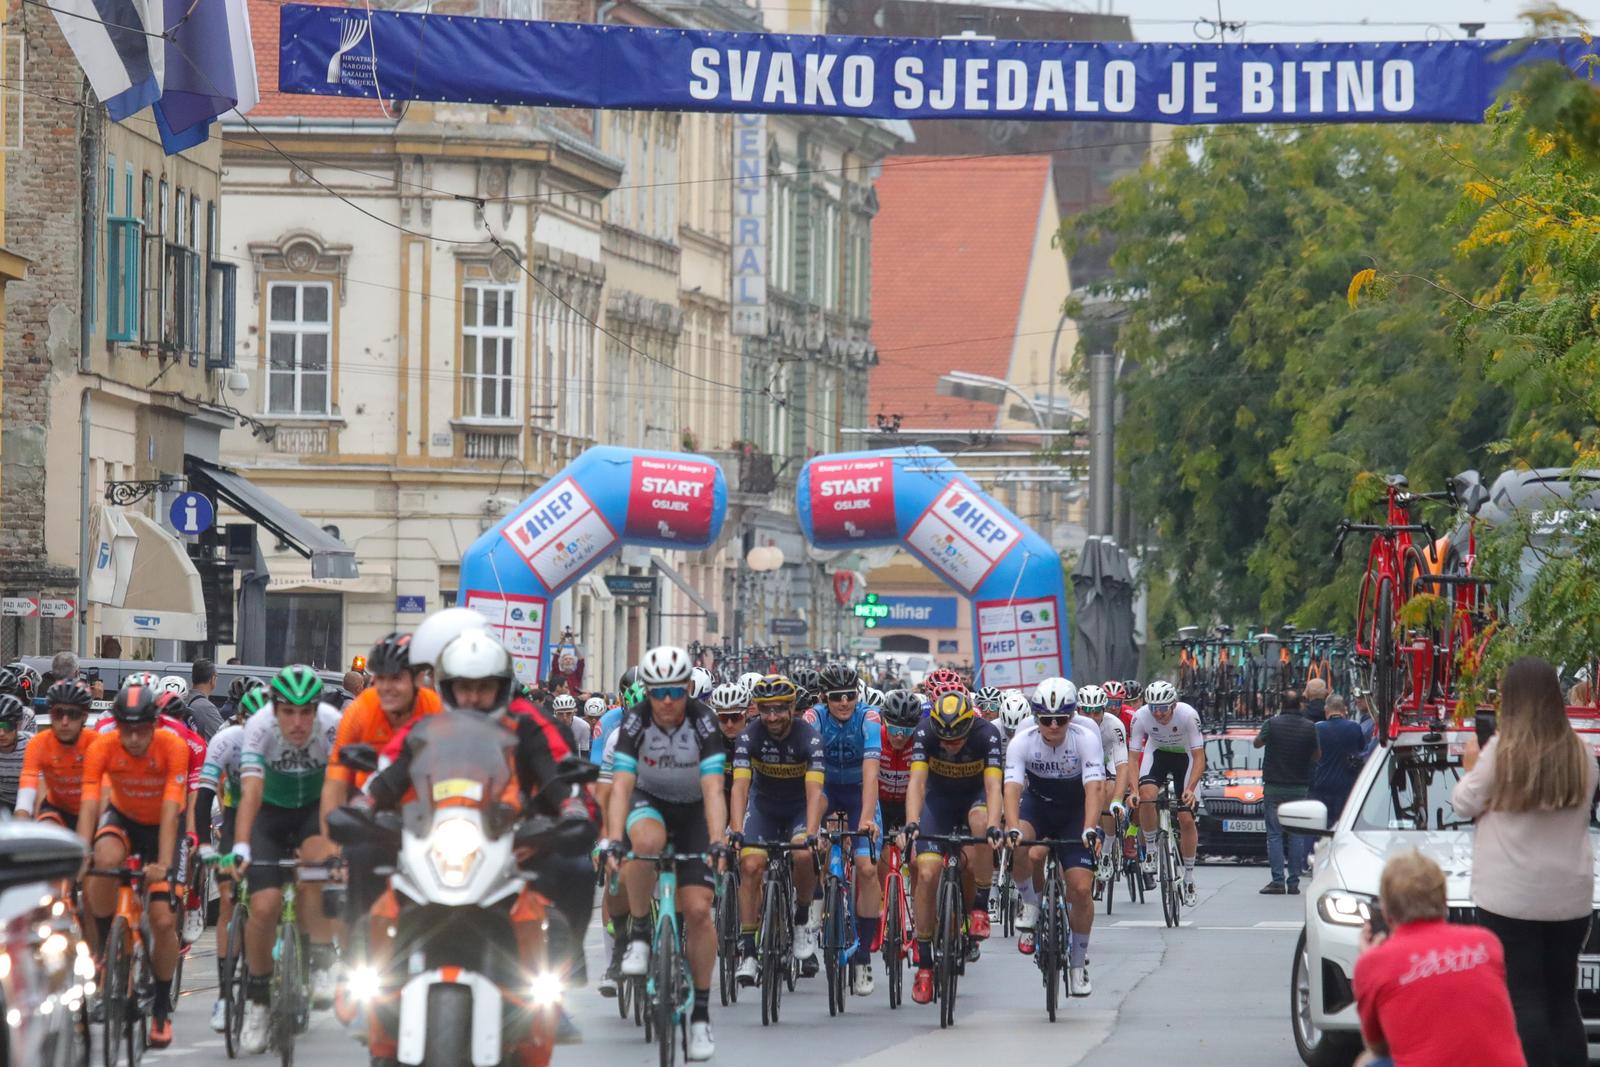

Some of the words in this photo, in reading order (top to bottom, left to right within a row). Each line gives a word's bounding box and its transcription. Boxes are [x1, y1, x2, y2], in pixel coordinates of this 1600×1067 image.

[689, 47, 875, 108] SVAKO
[893, 56, 1136, 113] SJEDALO
[1157, 62, 1218, 114] JE
[1242, 59, 1415, 114] BITNO
[641, 477, 704, 498] START
[820, 477, 882, 496] START
[533, 491, 573, 531] HEP
[651, 499, 689, 512] OSIJEK
[833, 499, 871, 511] OSIJEK
[962, 508, 1007, 543] HEP
[993, 640, 1015, 654] HEP
[1031, 761, 1060, 771] ISRAEL
[1229, 821, 1253, 831] 4950
